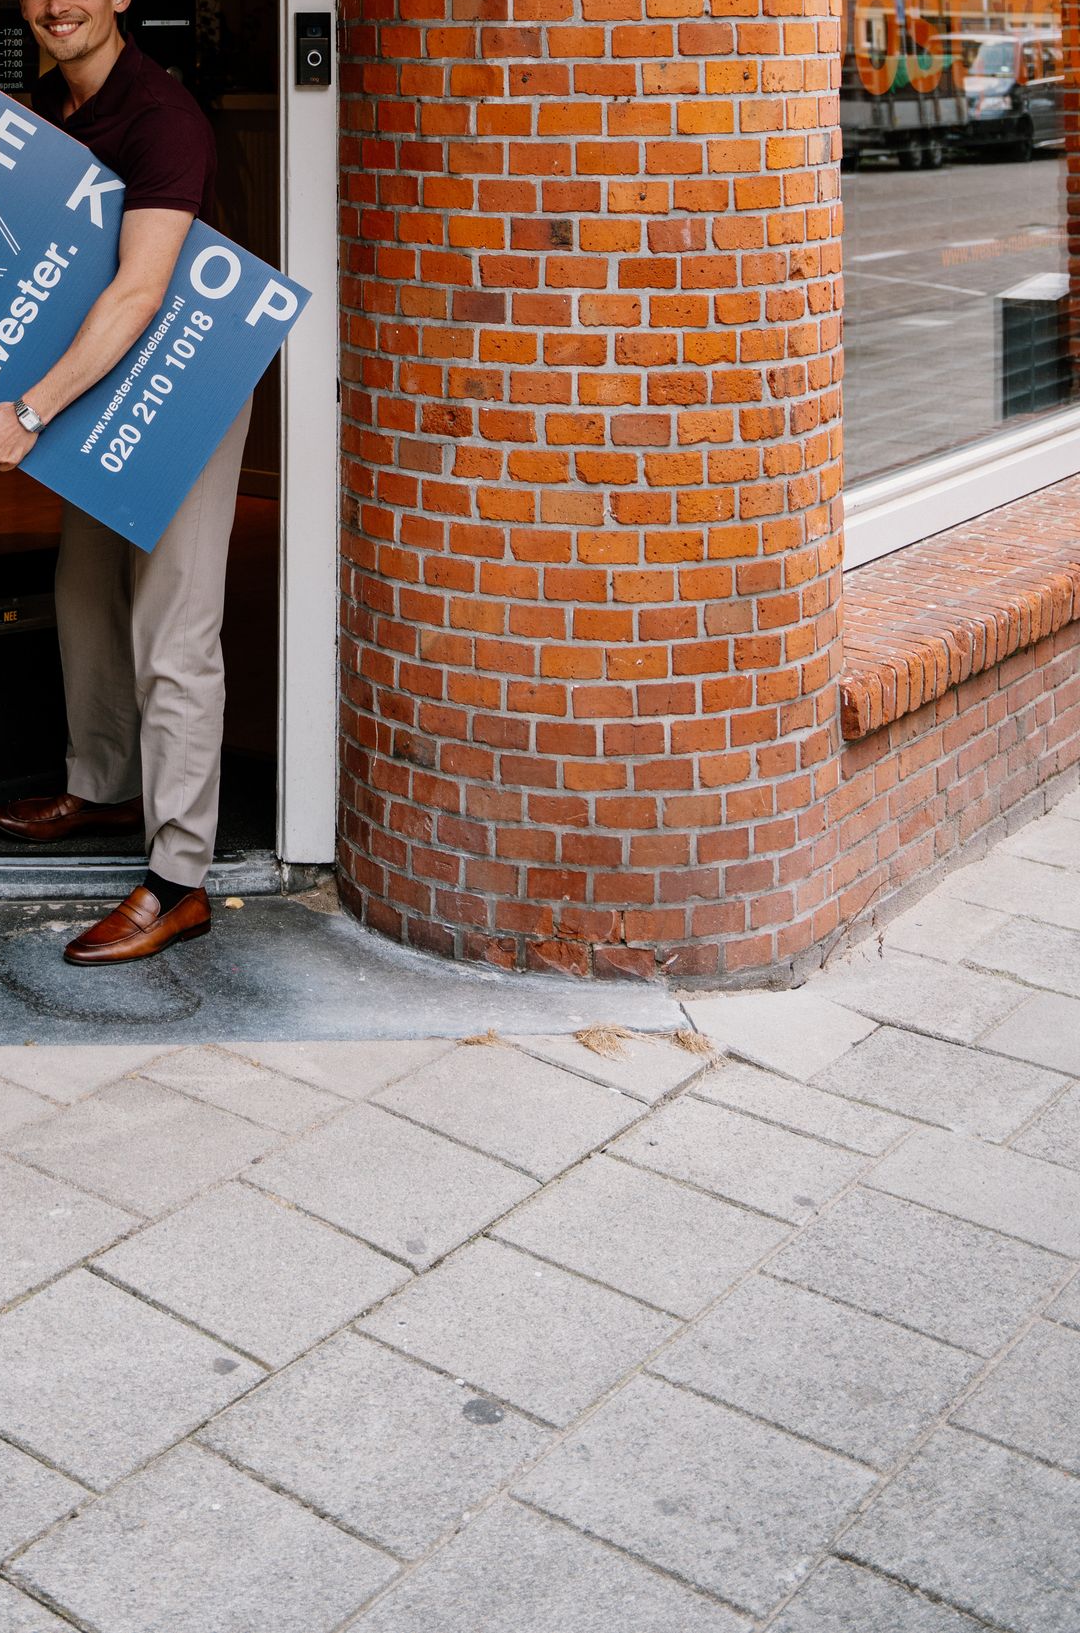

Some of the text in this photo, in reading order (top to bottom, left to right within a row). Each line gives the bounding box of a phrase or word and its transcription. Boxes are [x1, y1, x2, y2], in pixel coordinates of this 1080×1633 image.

[80, 295, 186, 455] www.wester-makelaars.nl
[100, 310, 214, 474] 020 210 1018
[4, 611, 18, 622] NEE
